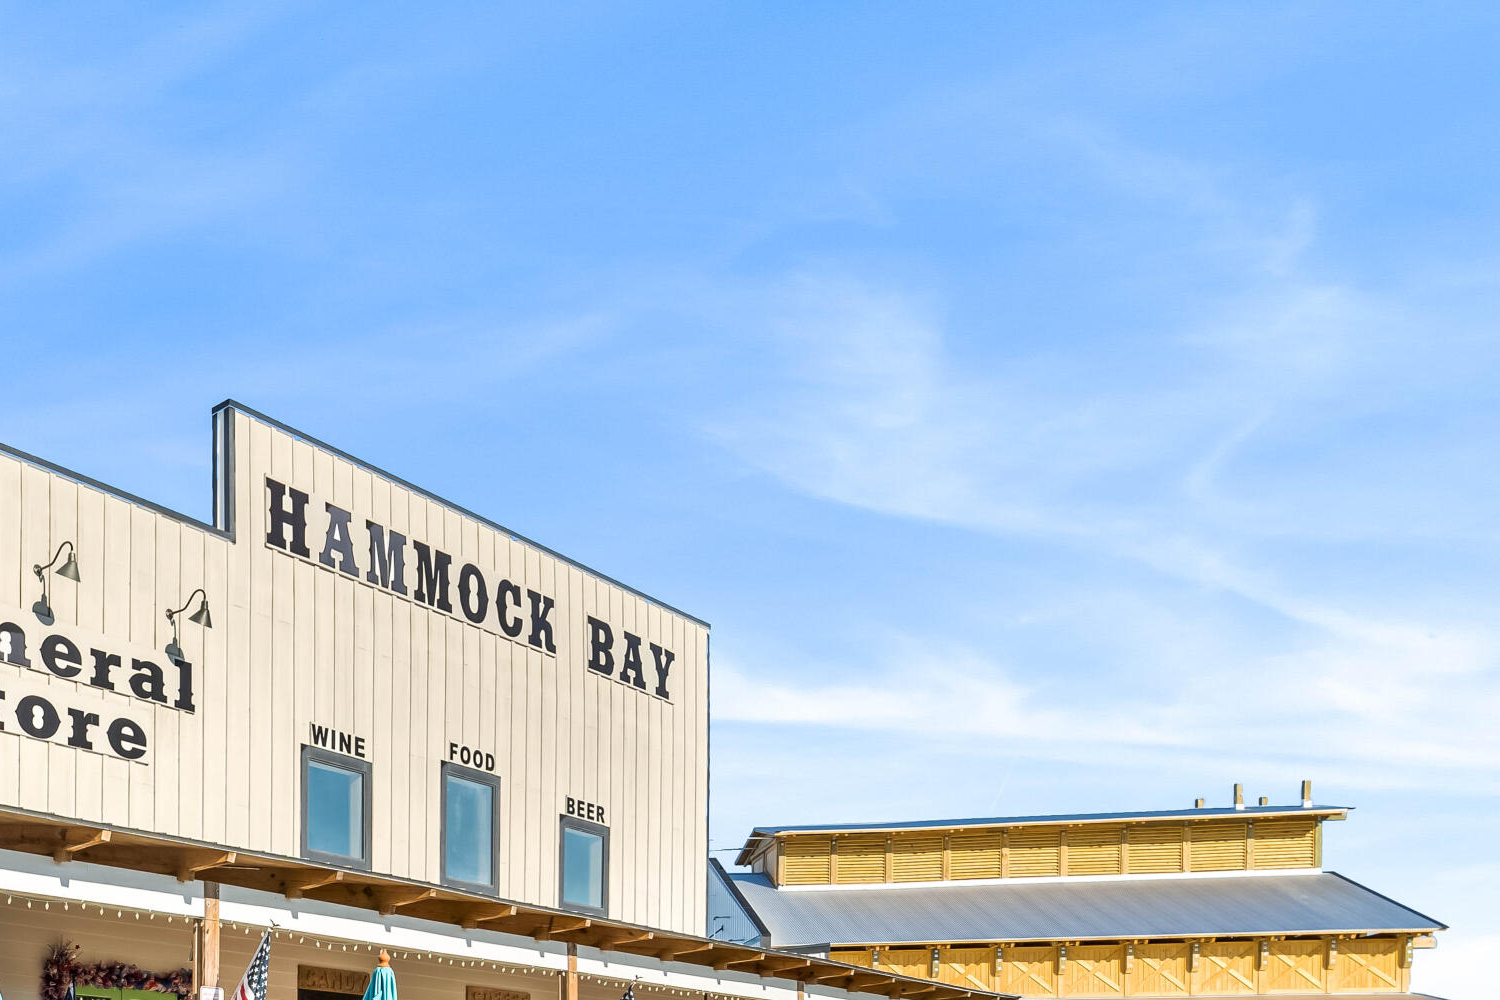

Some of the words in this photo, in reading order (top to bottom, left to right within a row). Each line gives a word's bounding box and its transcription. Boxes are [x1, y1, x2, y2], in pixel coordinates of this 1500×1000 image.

[266, 477, 556, 655] HAMMOCK
[587, 615, 675, 699] BAY
[311, 723, 366, 758] WINE
[449, 742, 495, 772] FOOD
[565, 796, 605, 824] BEER
